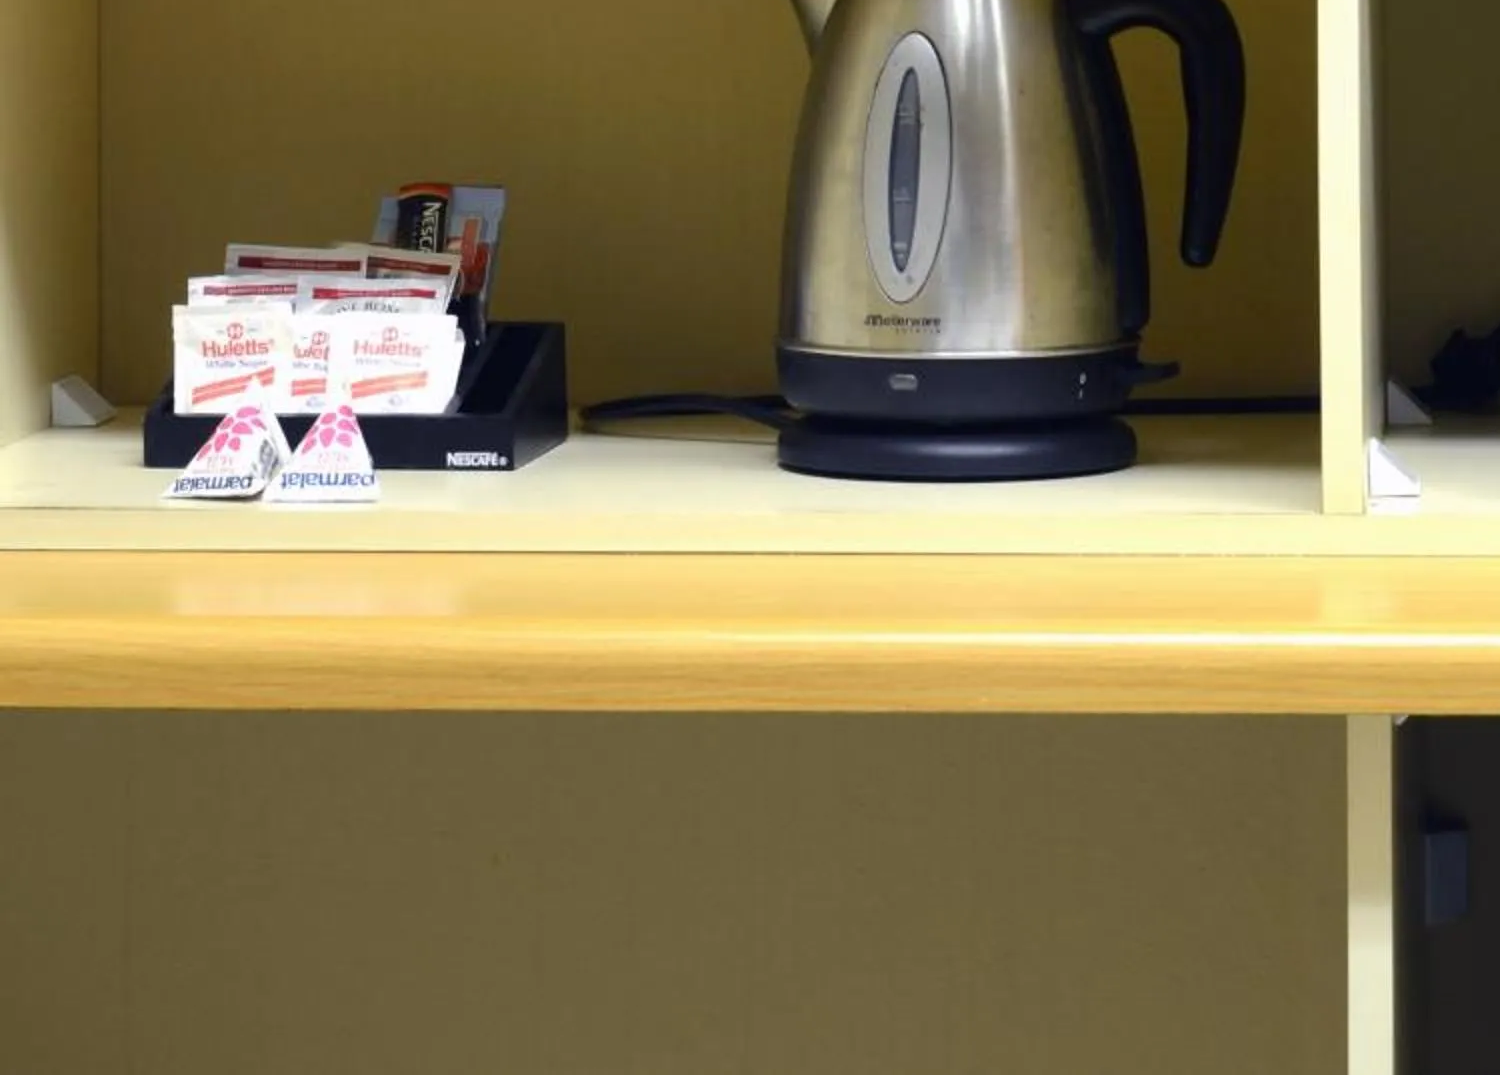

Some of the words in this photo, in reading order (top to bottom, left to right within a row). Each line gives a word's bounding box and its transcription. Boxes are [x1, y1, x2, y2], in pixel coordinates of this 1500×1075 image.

[202, 339, 270, 358] Huletts
[353, 340, 422, 357] Huletts
[173, 476, 254, 494] parmalat
[279, 472, 375, 490] parmalat
